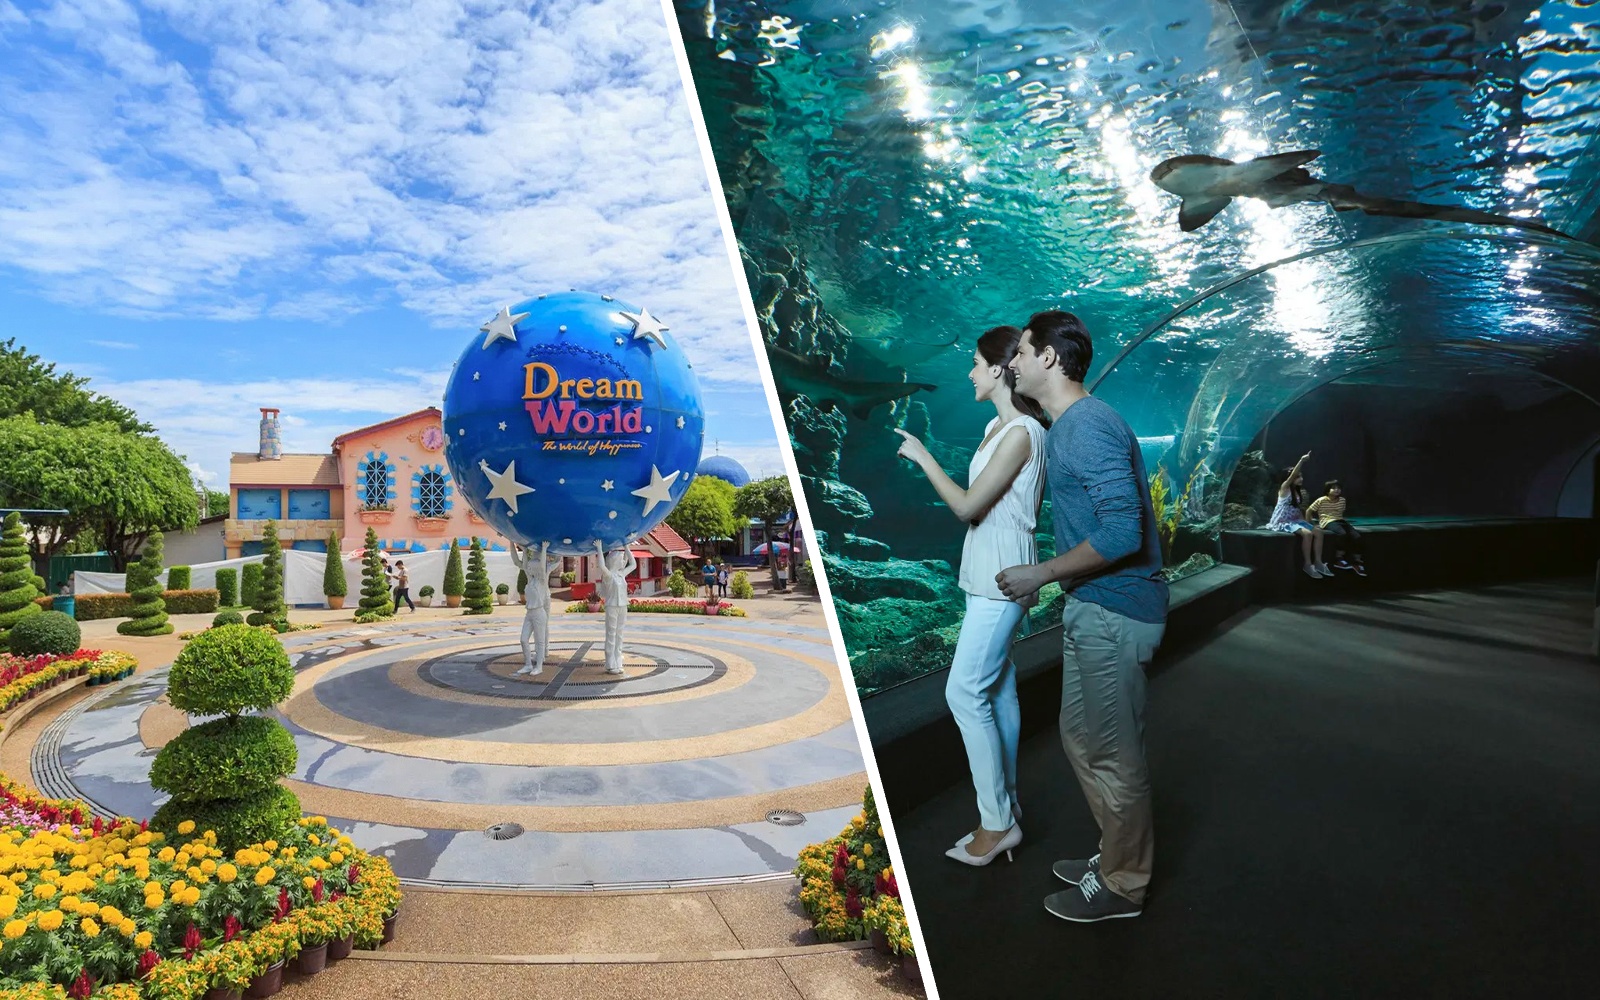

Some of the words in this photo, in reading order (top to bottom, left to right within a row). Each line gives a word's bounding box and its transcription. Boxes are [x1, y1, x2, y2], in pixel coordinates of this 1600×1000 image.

[522, 363, 643, 399] Dream
[526, 400, 642, 434] World
[542, 441, 557, 450] The
[559, 440, 588, 451] World
[588, 440, 600, 456] of
